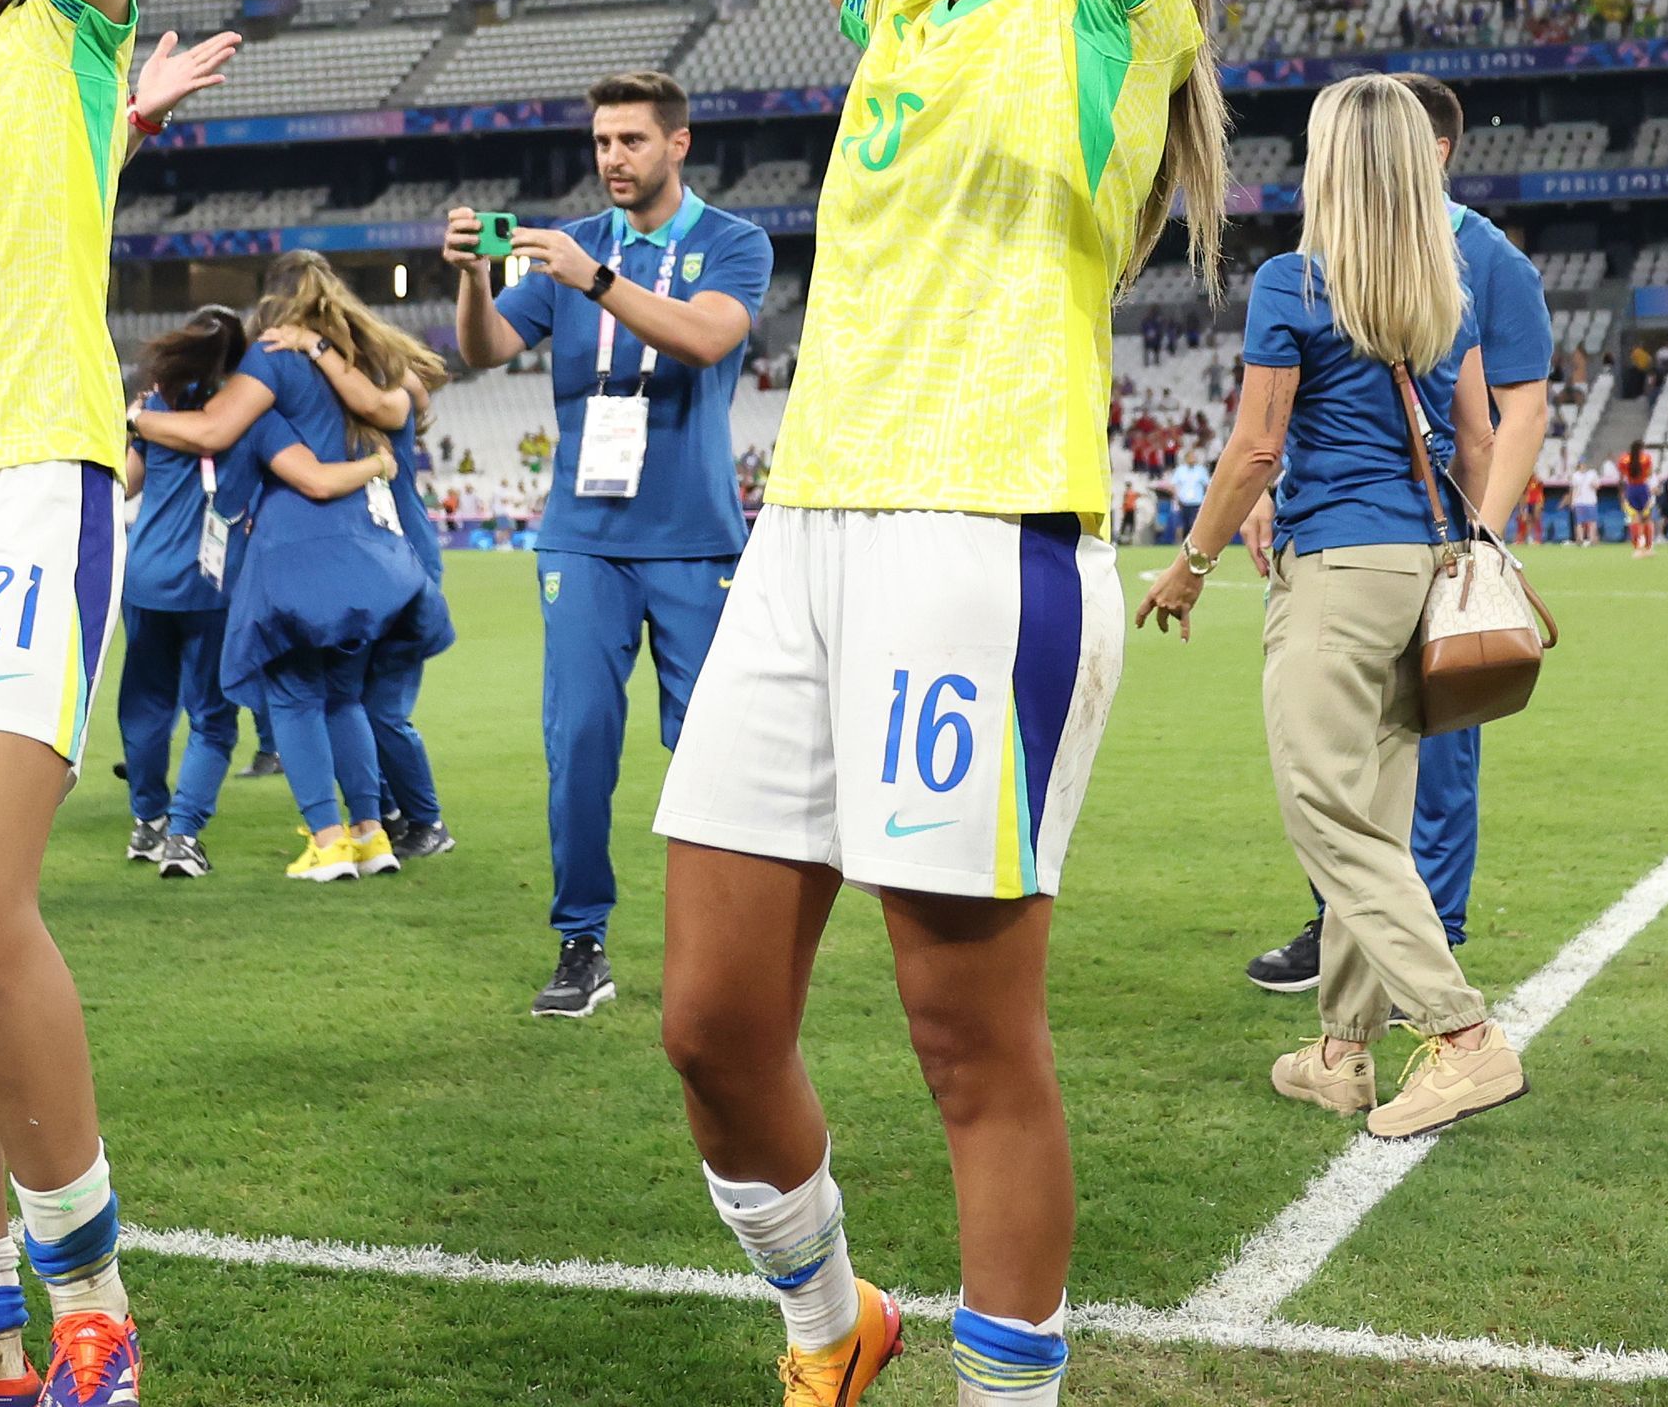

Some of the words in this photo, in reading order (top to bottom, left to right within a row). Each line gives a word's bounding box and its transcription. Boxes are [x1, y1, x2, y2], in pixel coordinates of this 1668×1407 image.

[1410, 55, 1472, 72] PARIS
[1479, 51, 1537, 70] 2024
[1545, 176, 1611, 196] PARIS
[880, 668, 978, 793] 16
